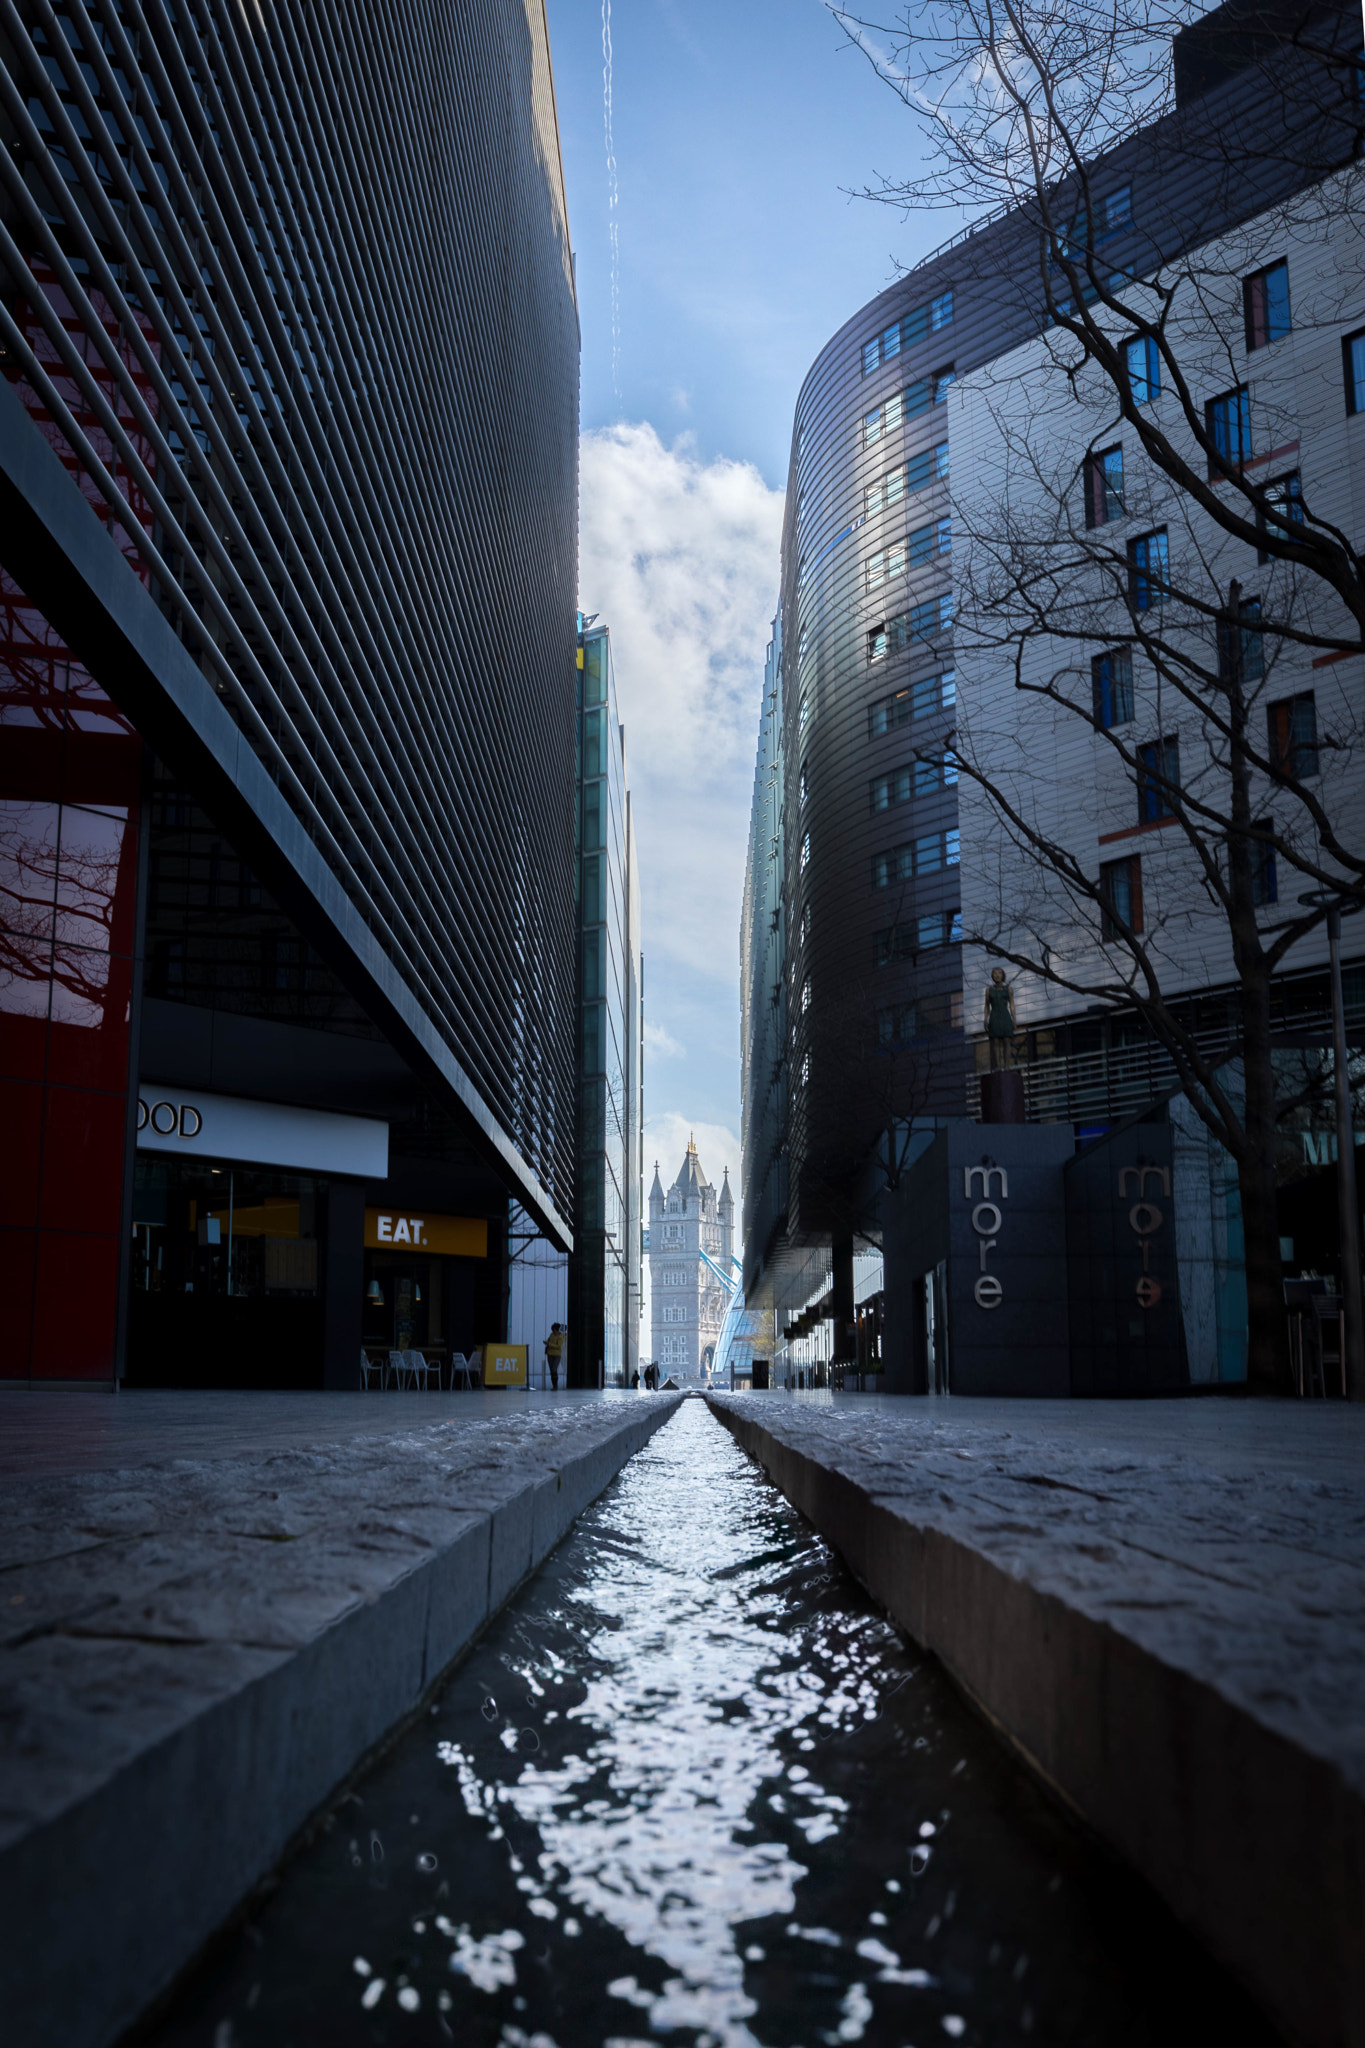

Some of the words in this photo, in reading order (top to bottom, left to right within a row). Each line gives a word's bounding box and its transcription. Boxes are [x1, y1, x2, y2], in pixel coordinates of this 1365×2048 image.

[377, 1215, 428, 1246] EAT.
[964, 1166, 1008, 1309] more
[495, 1357, 519, 1372] EAT.
